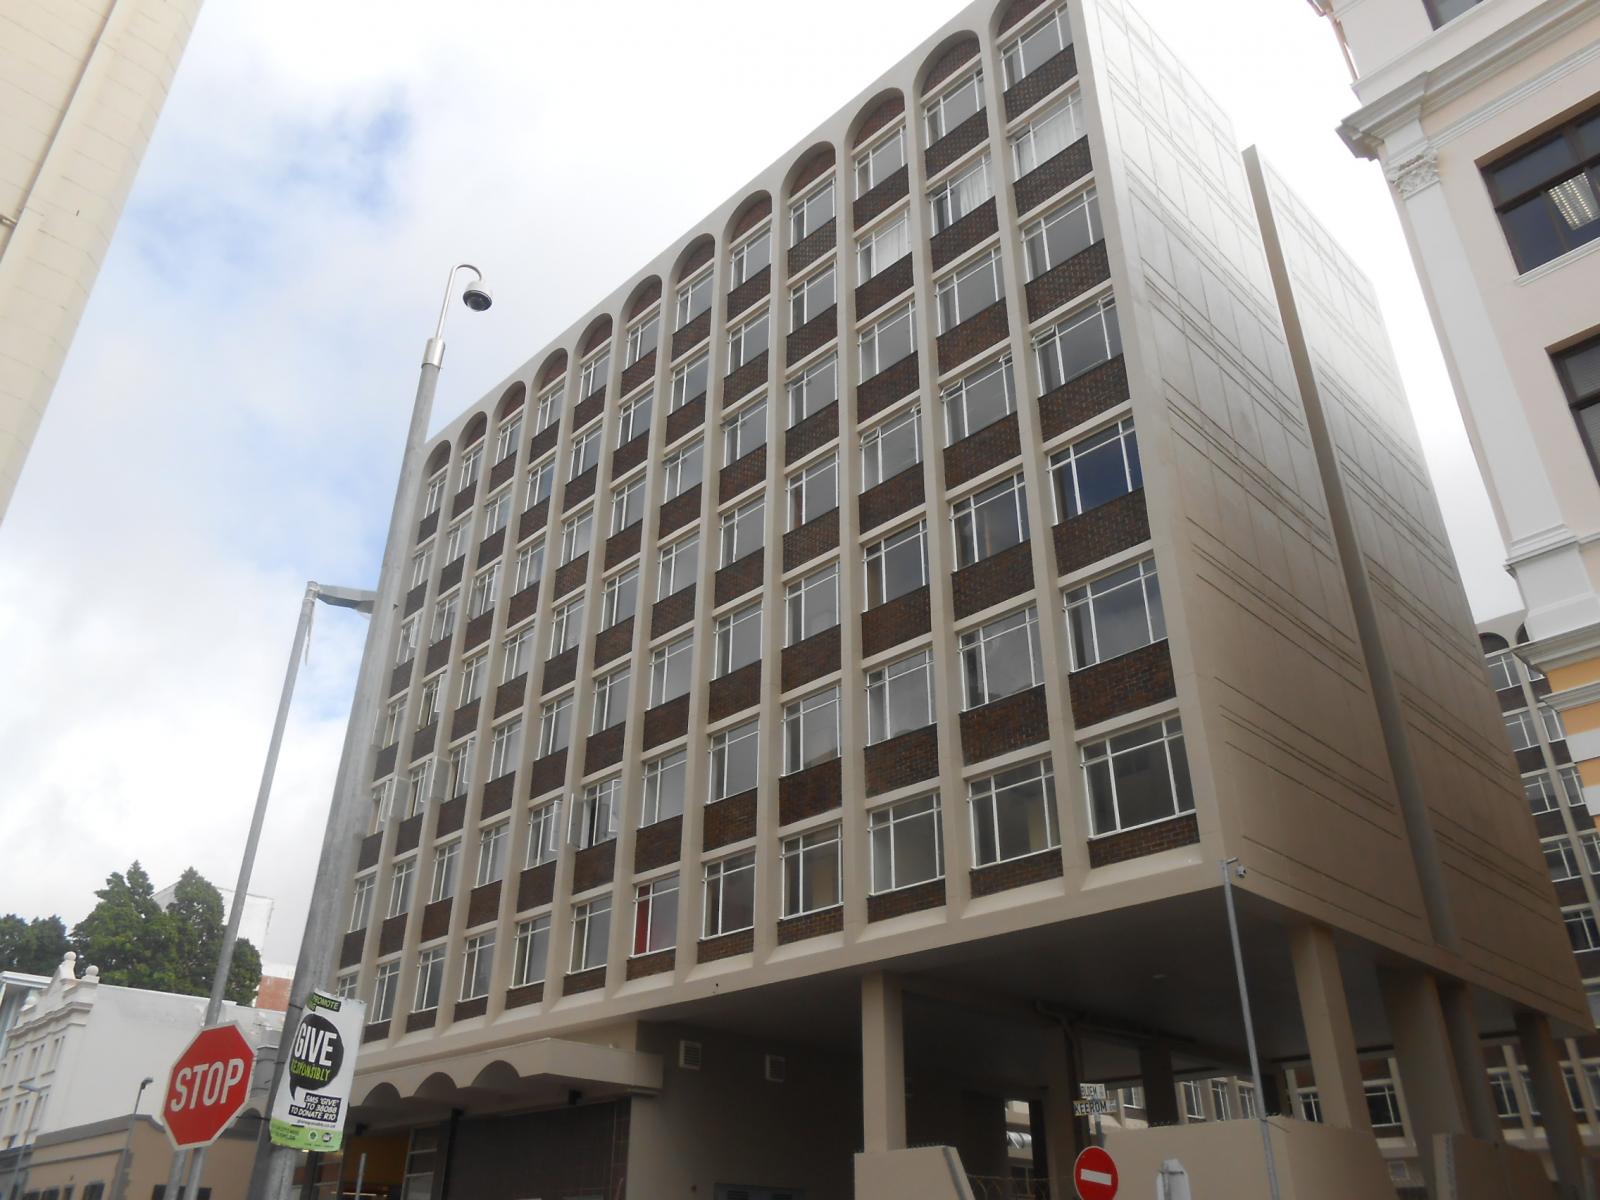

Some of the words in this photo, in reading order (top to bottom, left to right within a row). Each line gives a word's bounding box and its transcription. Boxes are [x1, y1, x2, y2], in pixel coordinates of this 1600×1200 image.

[294, 1022, 337, 1066] GIVE
[170, 1058, 245, 1112] STOP
[305, 1094, 319, 1104] SMS
[290, 1107, 298, 1115] TO
[298, 1109, 323, 1119] DONATE
[1072, 1101, 1107, 1113] KEEROM
